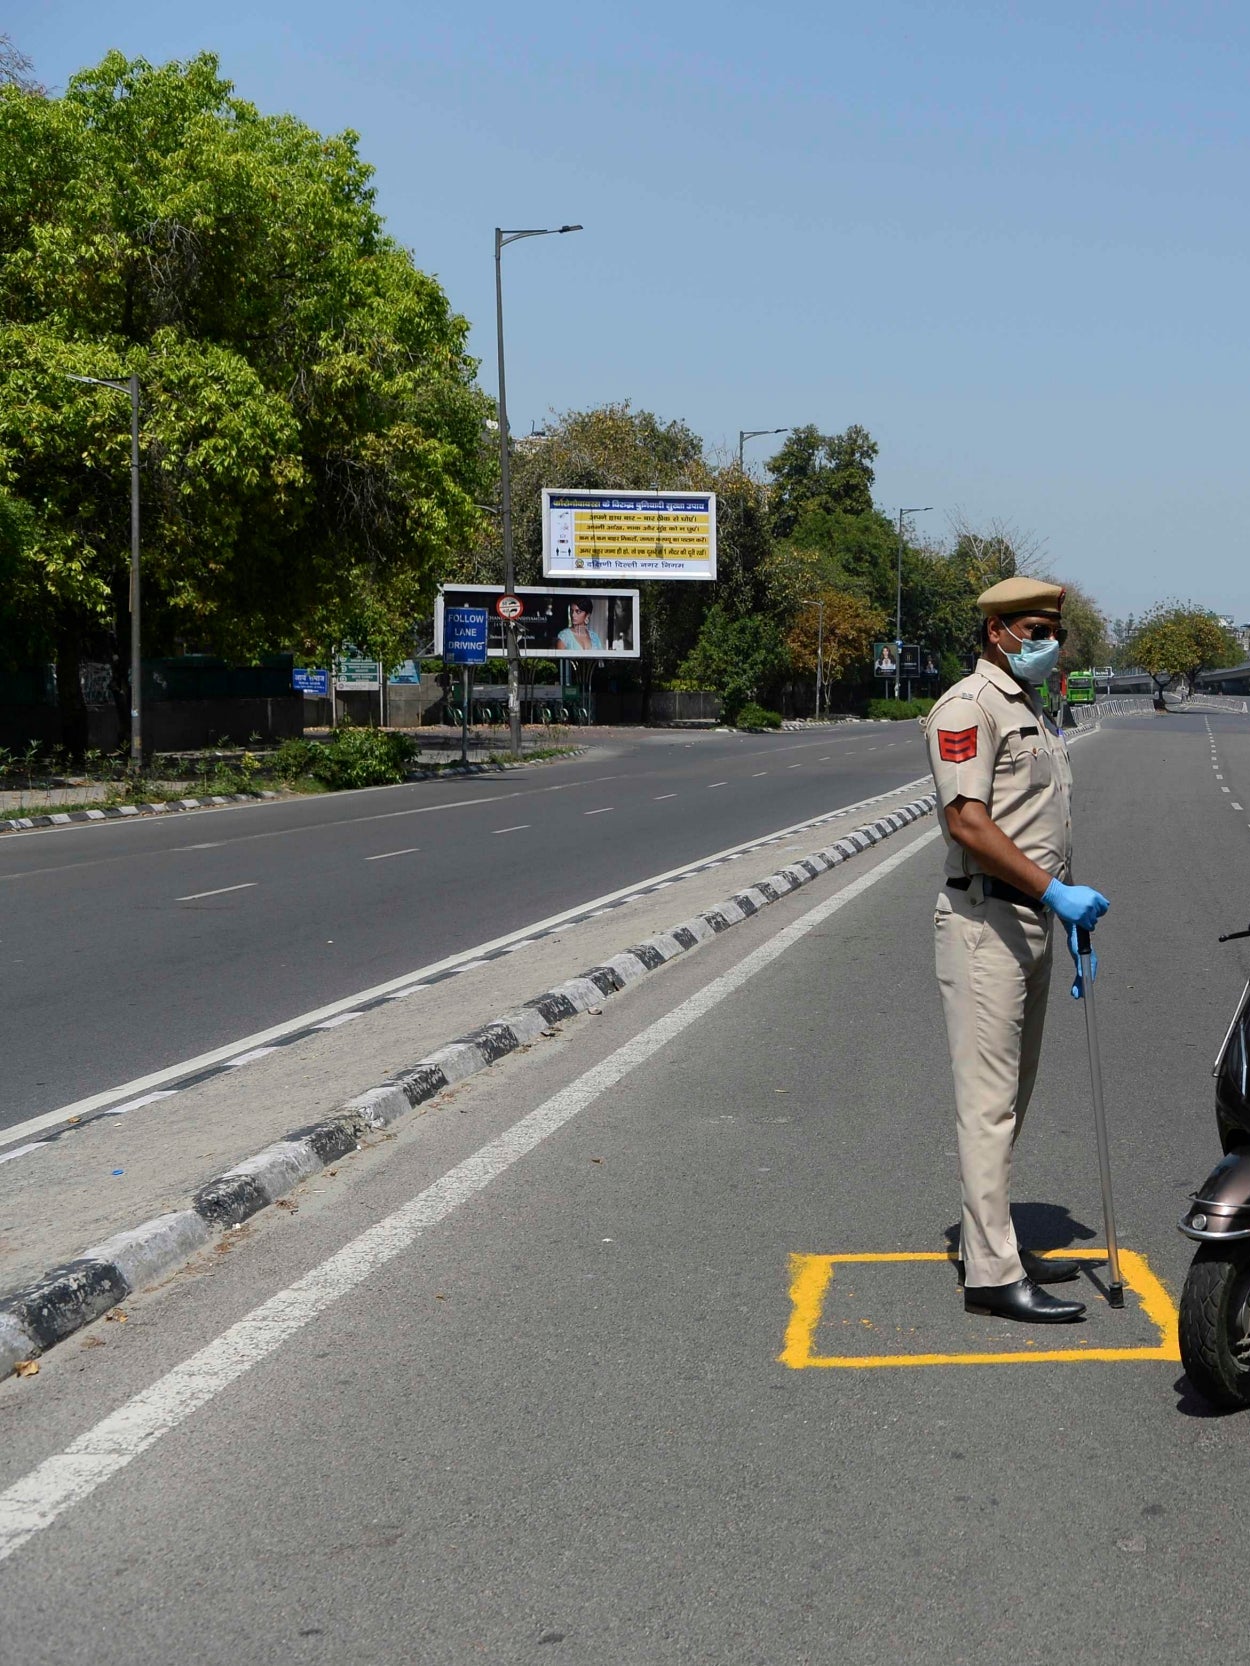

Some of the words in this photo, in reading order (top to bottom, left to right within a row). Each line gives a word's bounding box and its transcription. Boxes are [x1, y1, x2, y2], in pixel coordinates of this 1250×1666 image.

[448, 614, 484, 623] FOLLOW
[455, 628, 477, 637] LANE
[448, 641, 483, 650] DRIVING
